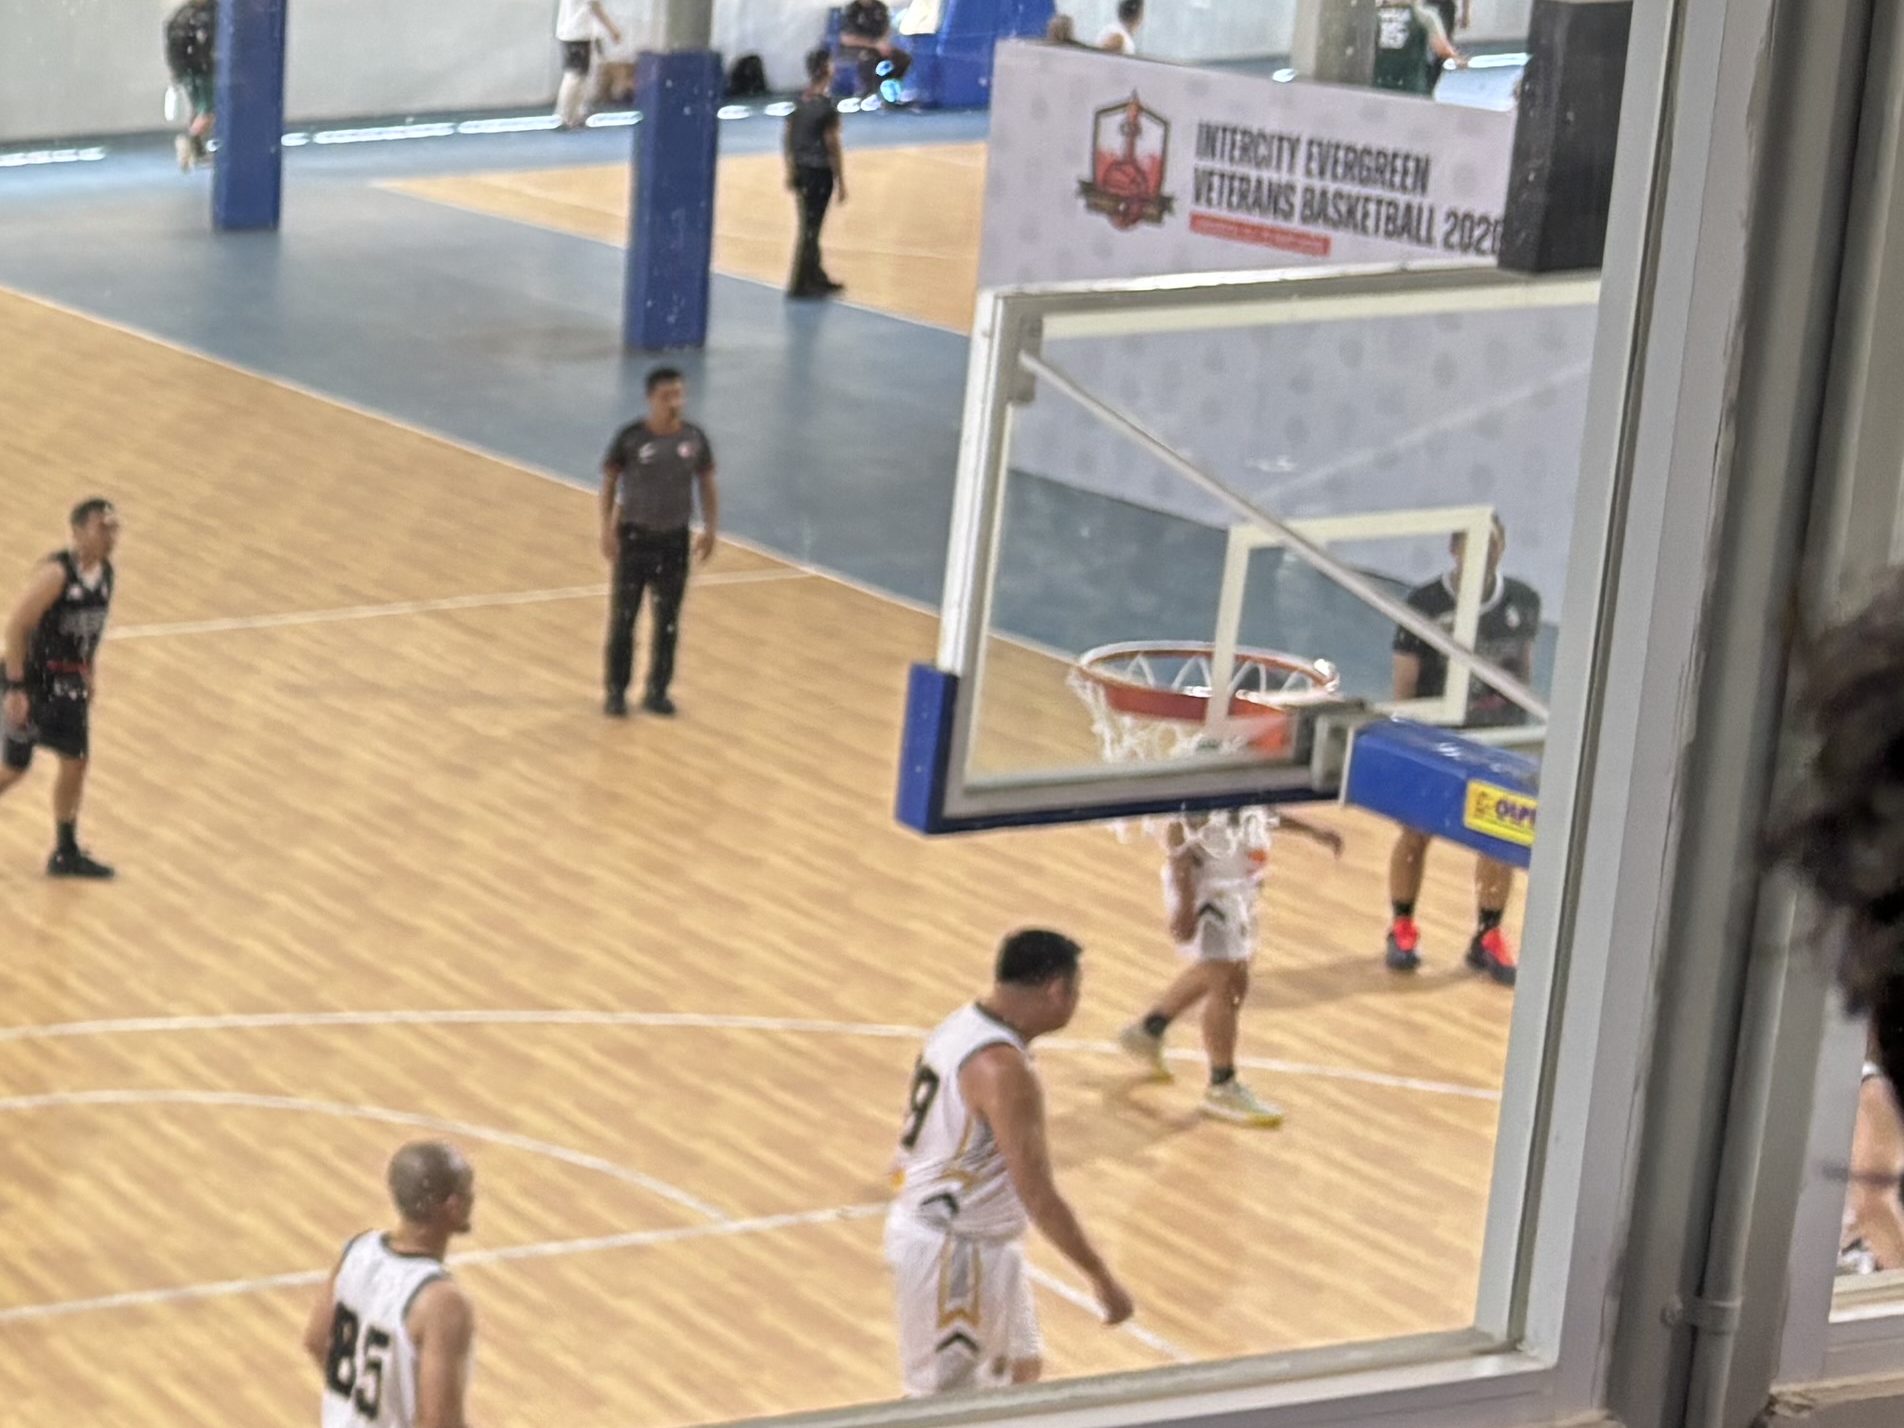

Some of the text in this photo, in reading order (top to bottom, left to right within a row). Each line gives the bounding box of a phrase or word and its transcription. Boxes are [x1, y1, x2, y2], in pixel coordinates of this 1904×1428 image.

[1195, 120, 1431, 196] INTERCITY EVERGREEN
[1193, 167, 1296, 221] VETERANS
[1299, 183, 1436, 246] BASKETBALL
[326, 1300, 390, 1420] 85
